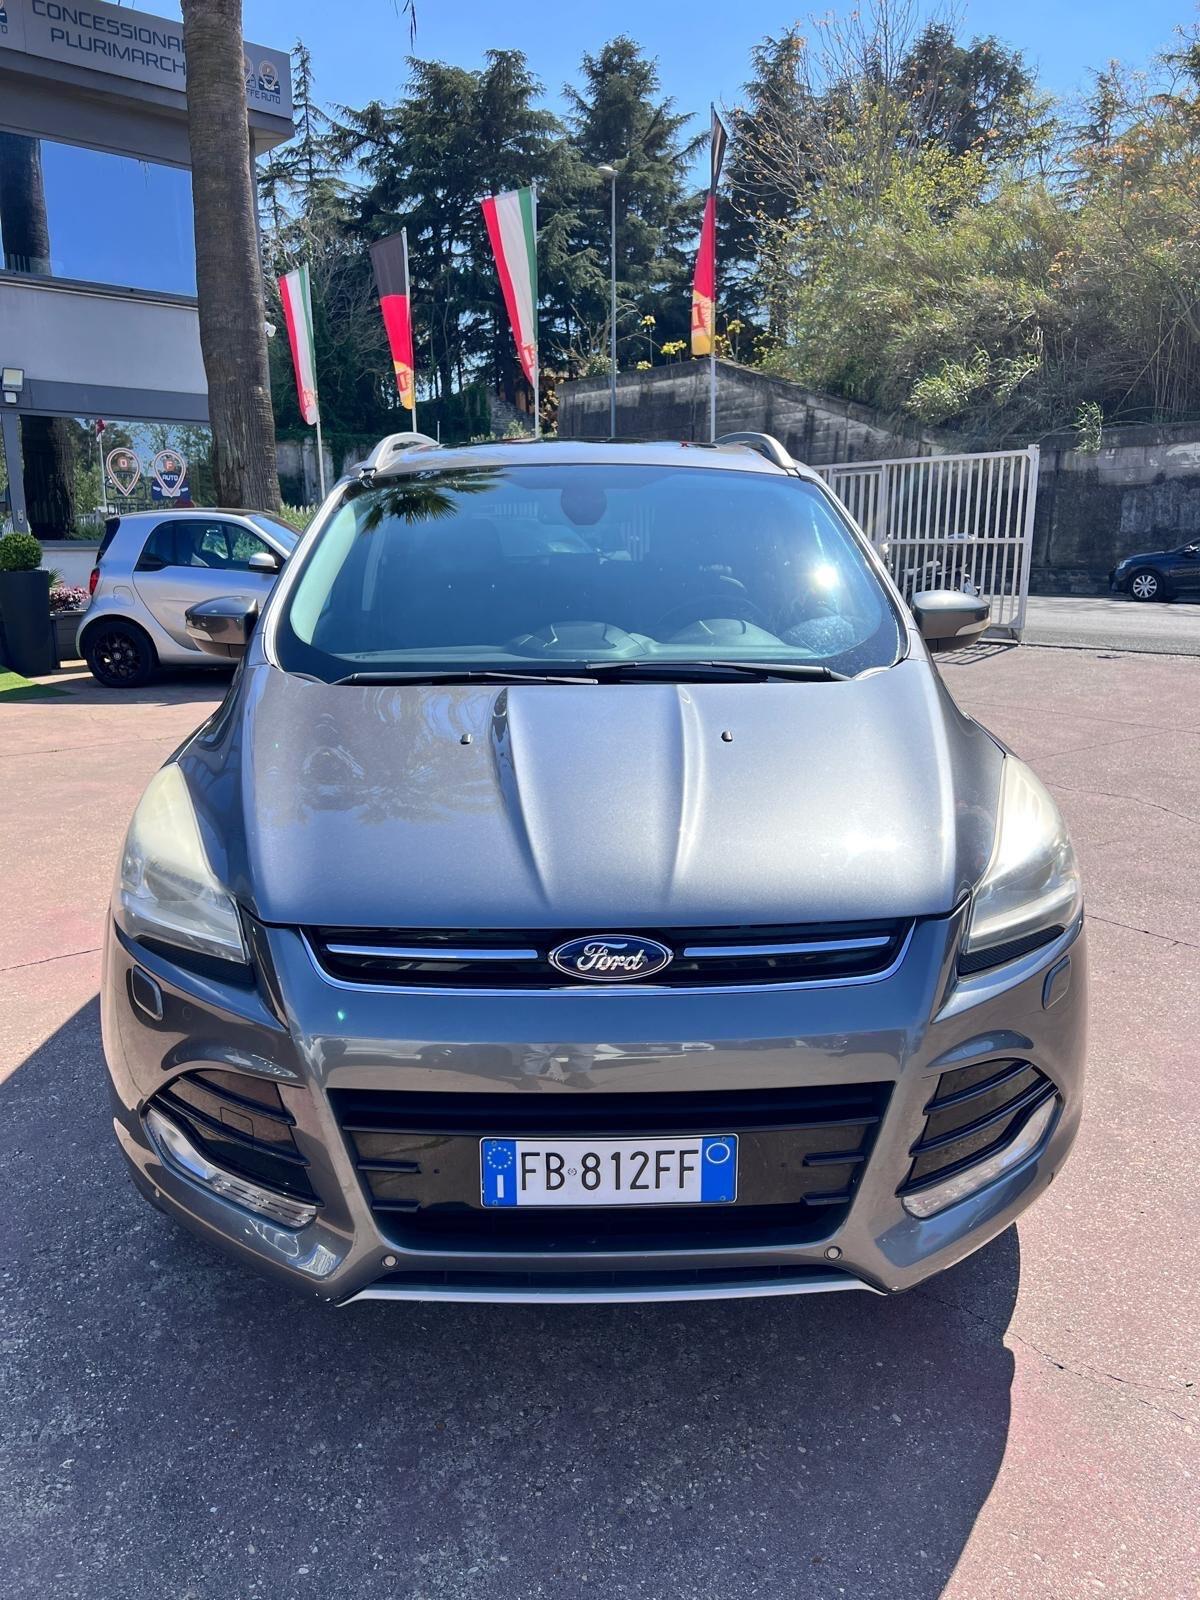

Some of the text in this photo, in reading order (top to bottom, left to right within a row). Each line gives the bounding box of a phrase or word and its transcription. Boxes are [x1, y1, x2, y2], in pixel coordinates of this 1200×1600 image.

[577, 942, 645, 971] Ford
[520, 1149, 699, 1191] FB 812FF
